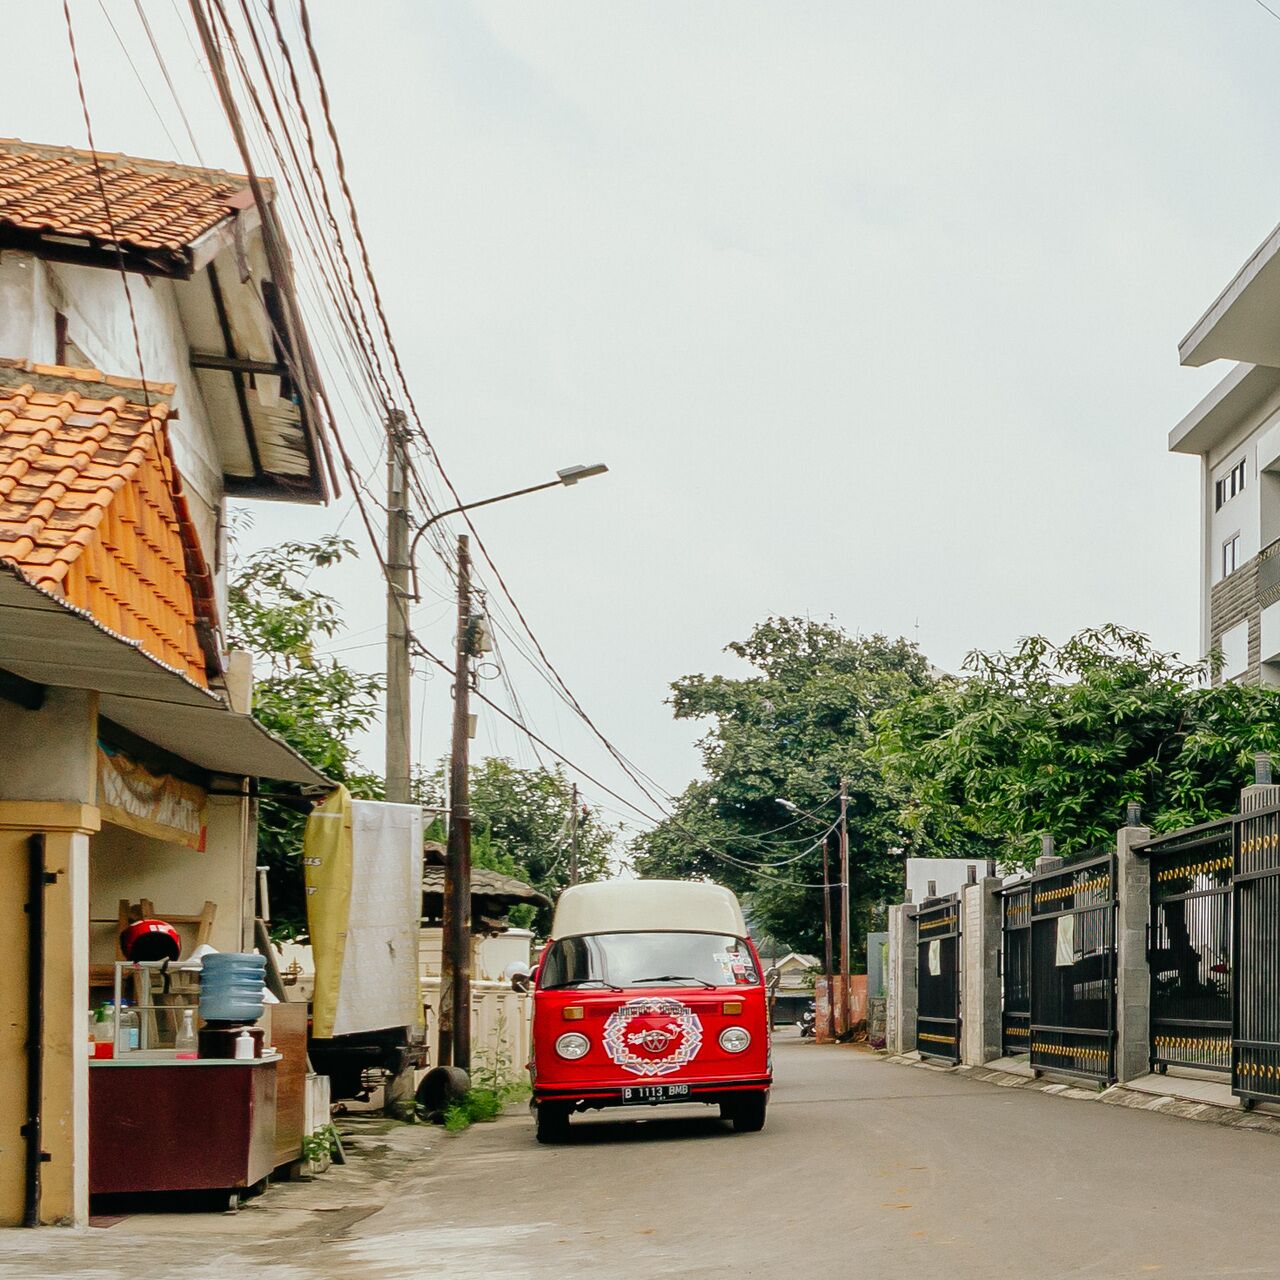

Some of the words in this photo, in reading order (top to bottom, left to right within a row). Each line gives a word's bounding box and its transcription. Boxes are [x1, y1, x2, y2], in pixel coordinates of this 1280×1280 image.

[625, 1088, 632, 1099] B
[639, 1086, 663, 1097] 1113
[668, 1085, 688, 1096] BMB
